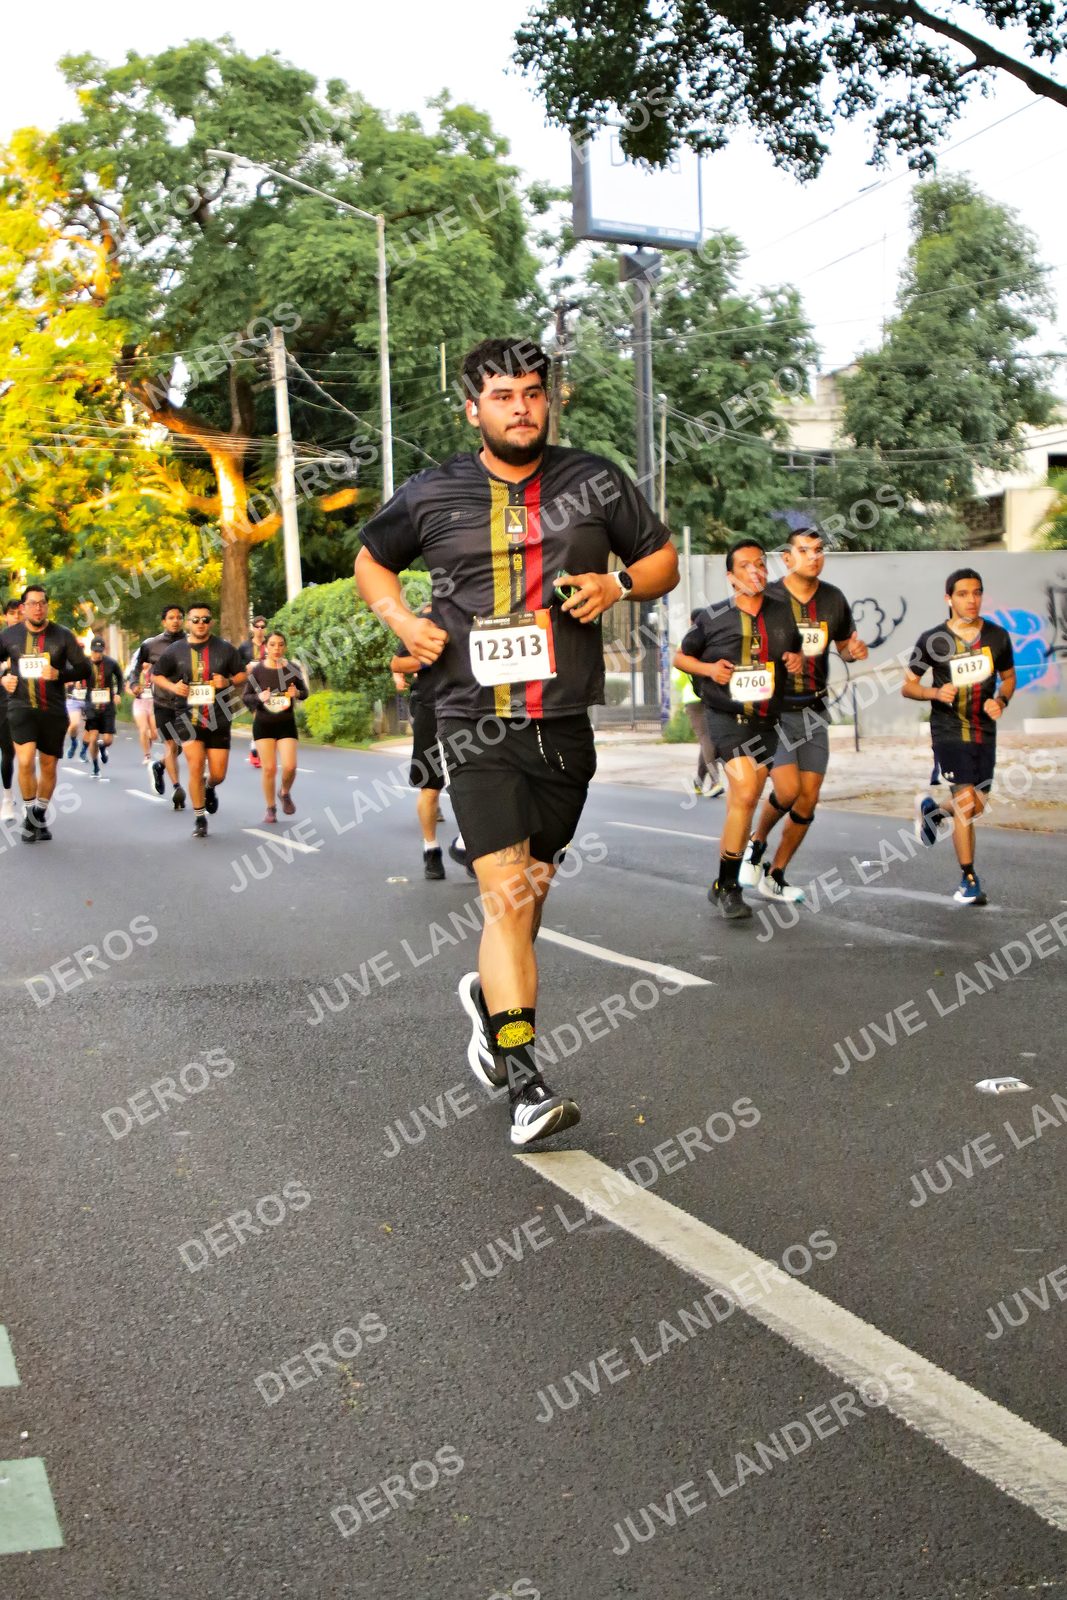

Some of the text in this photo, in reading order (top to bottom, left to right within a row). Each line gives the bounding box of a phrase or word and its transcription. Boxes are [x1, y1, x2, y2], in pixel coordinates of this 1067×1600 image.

[803, 633, 819, 644] 38
[474, 634, 542, 661] 12313
[957, 660, 983, 674] 6137
[736, 676, 766, 687] 4760
